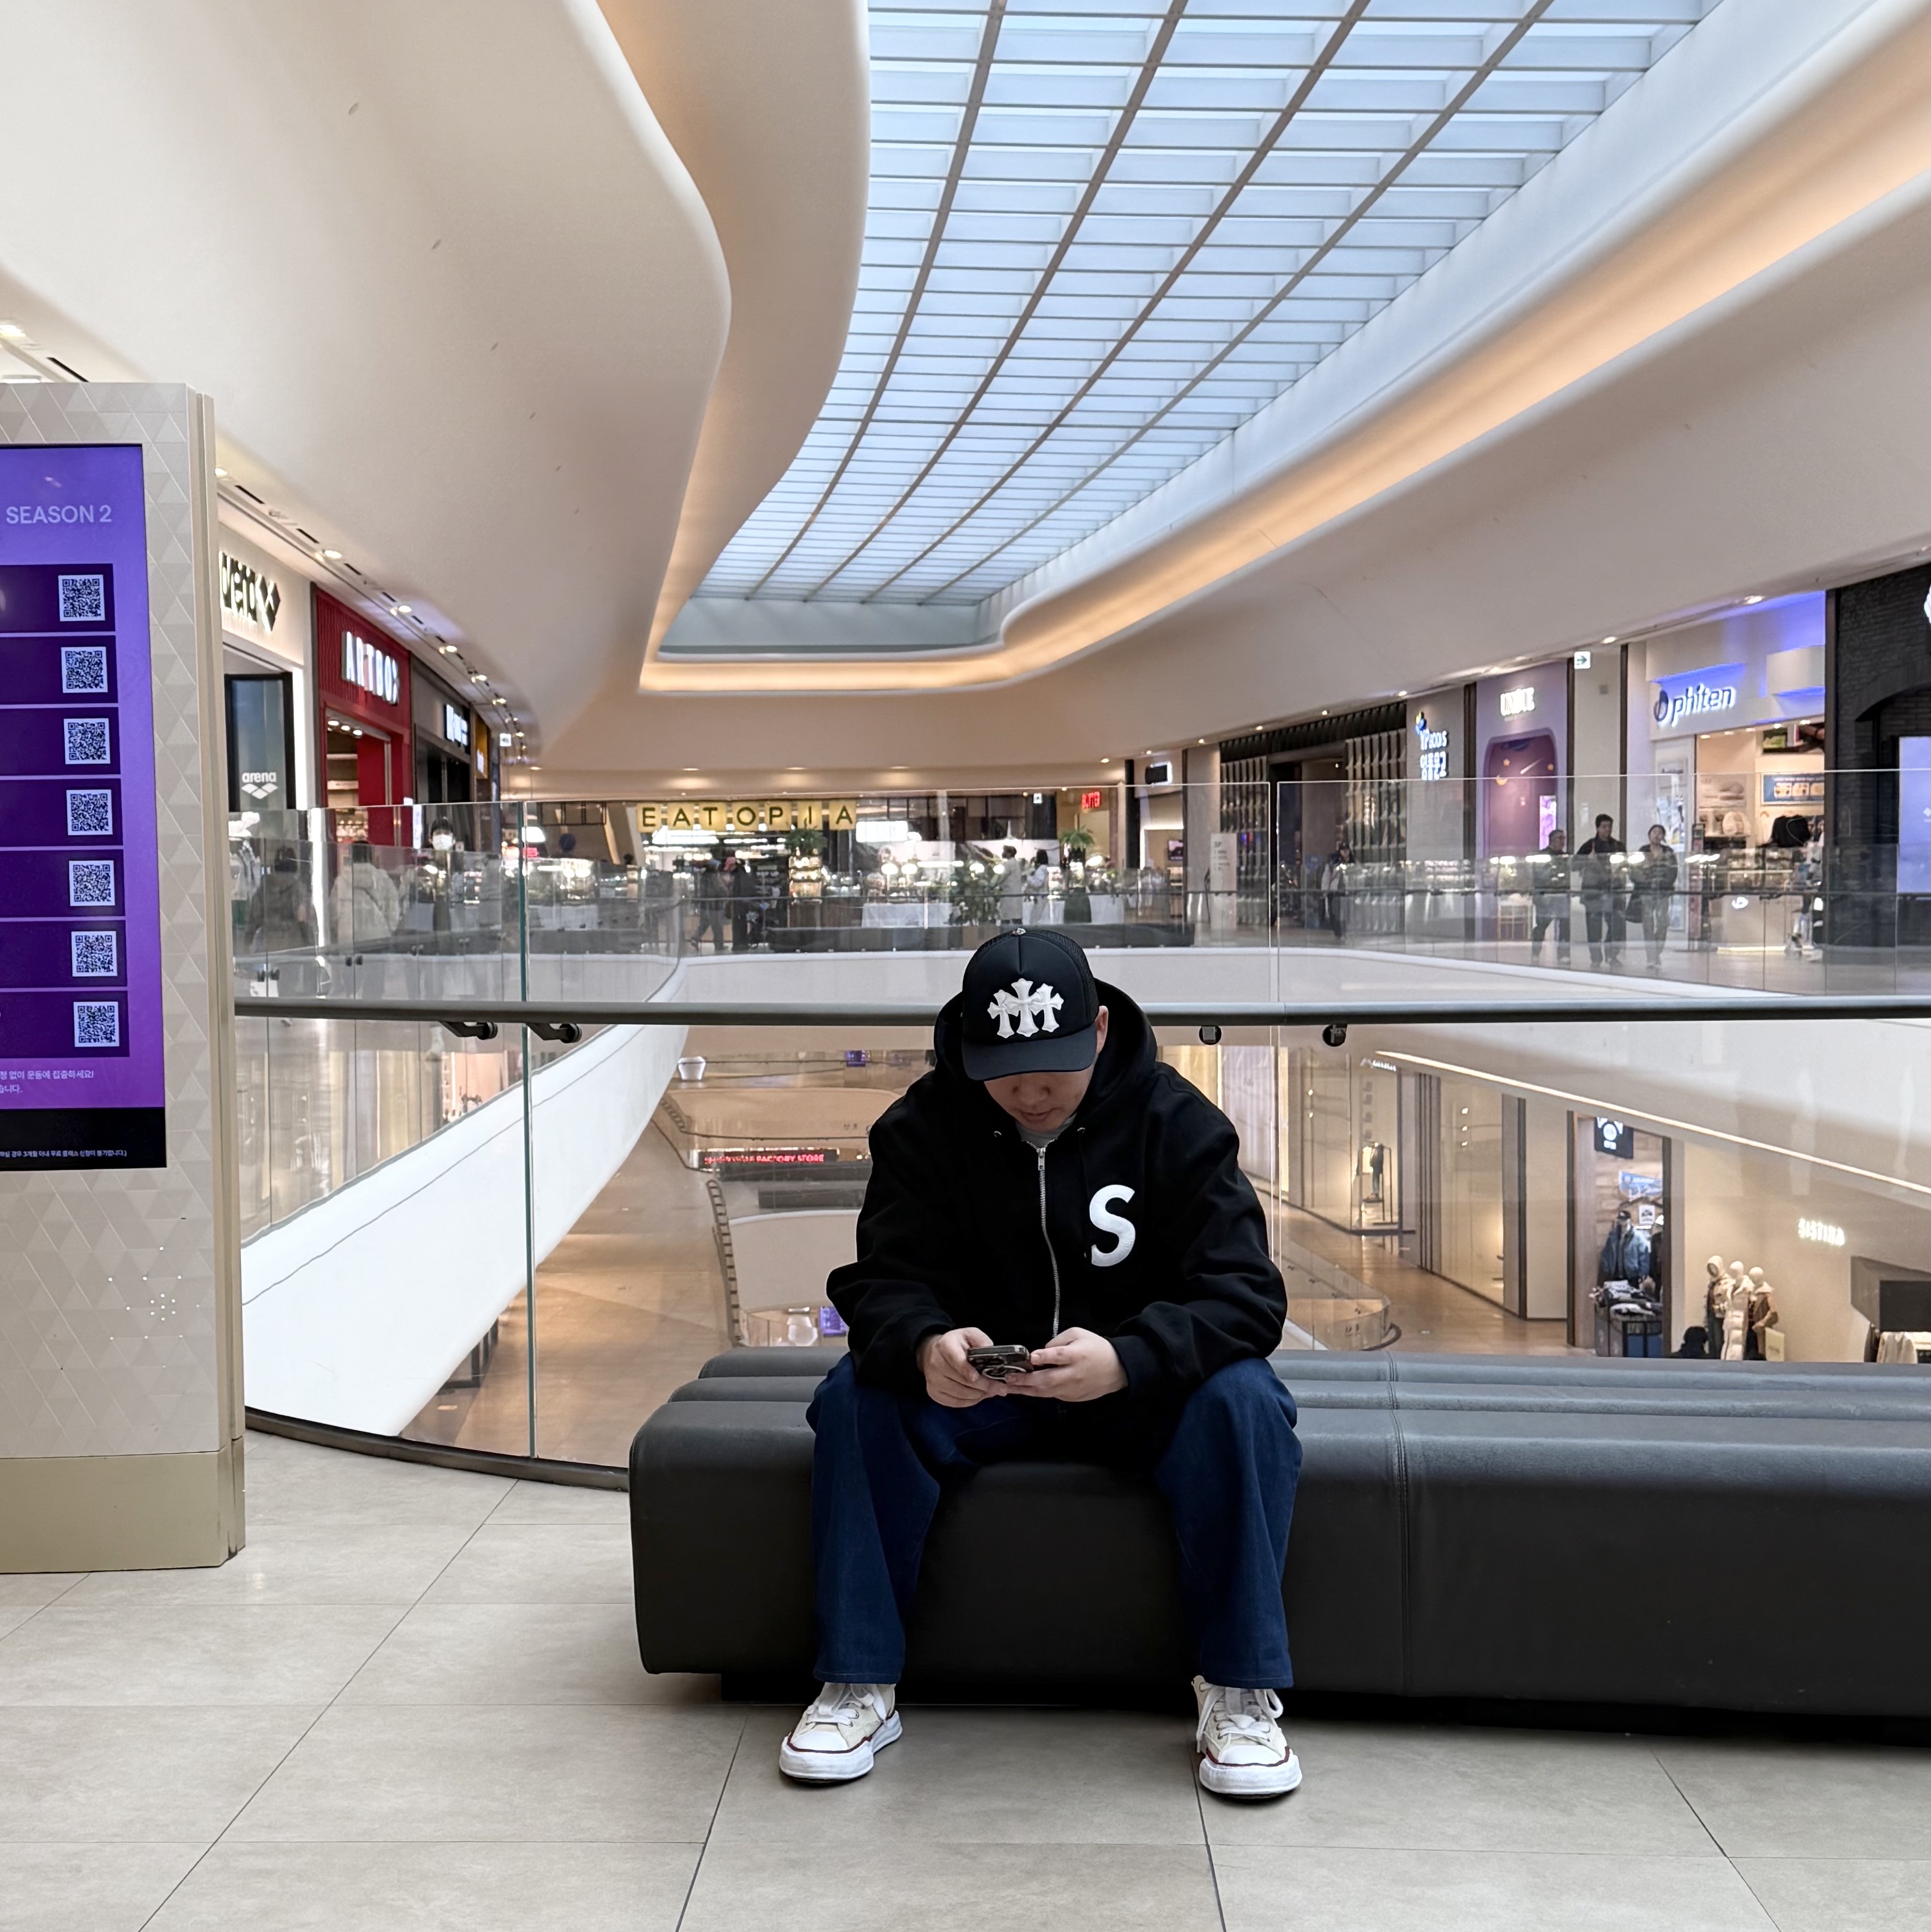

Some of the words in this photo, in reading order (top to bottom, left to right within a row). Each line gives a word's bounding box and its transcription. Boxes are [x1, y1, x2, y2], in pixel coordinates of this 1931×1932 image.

[6, 505, 94, 524] SEASON
[99, 505, 112, 523] 2
[1671, 684, 1736, 727] phiten
[242, 772, 277, 782] arena
[642, 805, 853, 827] EATOPIA
[27, 1070, 50, 1079] 운동에
[1089, 1184, 1136, 1267] S
